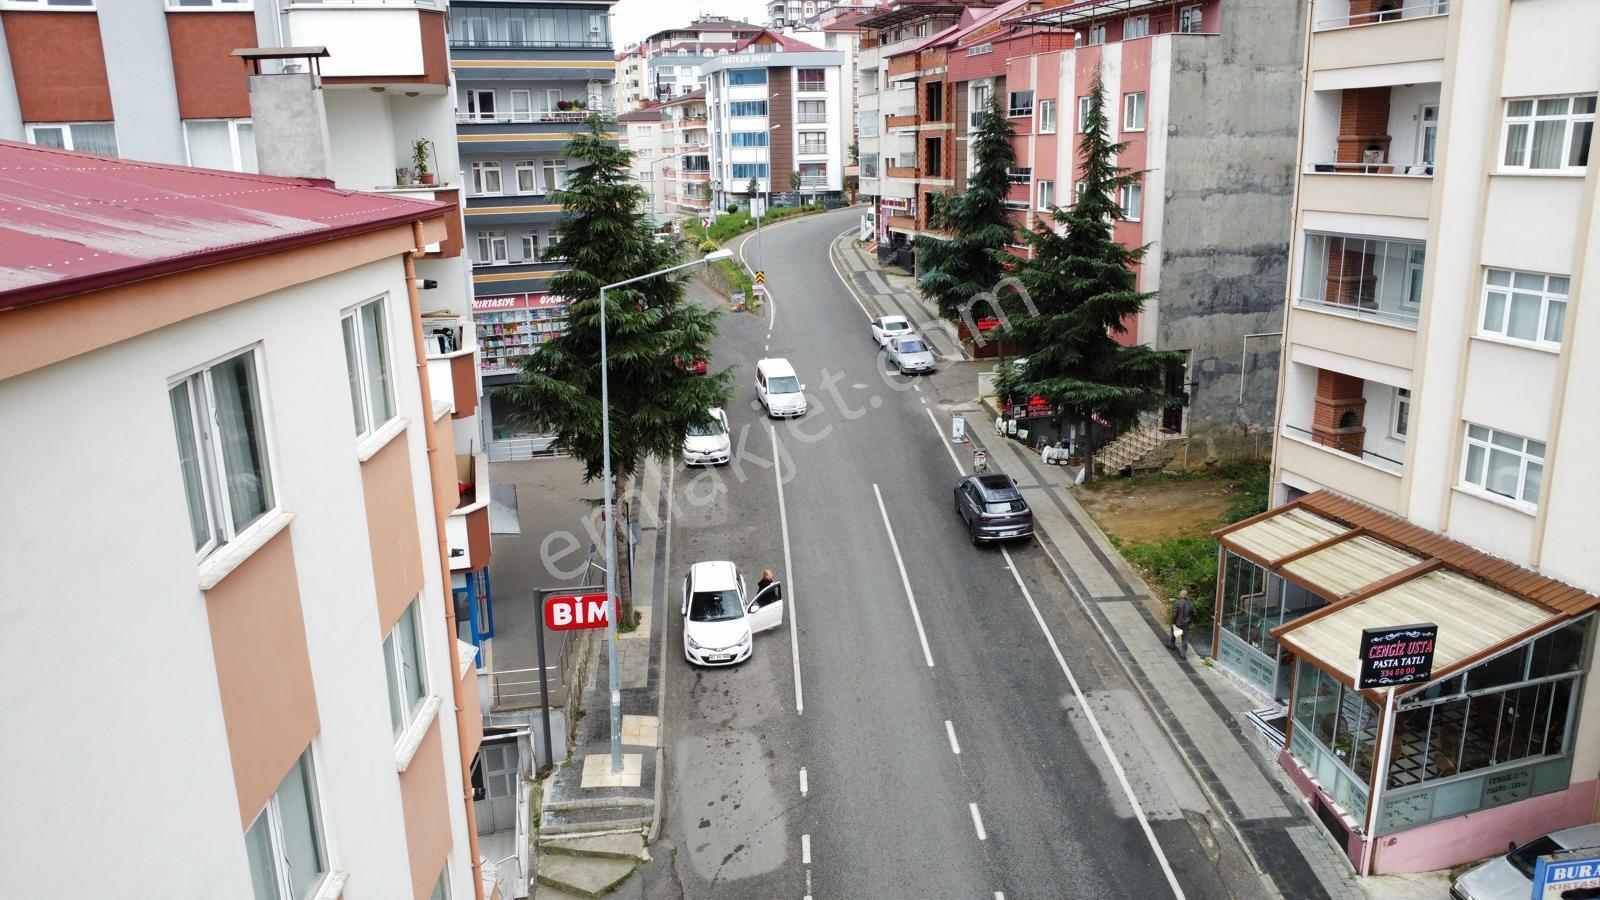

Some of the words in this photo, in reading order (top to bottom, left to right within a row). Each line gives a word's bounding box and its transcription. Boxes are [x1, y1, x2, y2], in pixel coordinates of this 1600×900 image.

[552, 596, 609, 626] BİM
[1369, 640, 1406, 658] CENGİZ
[1407, 640, 1433, 654] USTA
[1373, 659, 1398, 669] PASTA
[1401, 656, 1425, 666] TATLI
